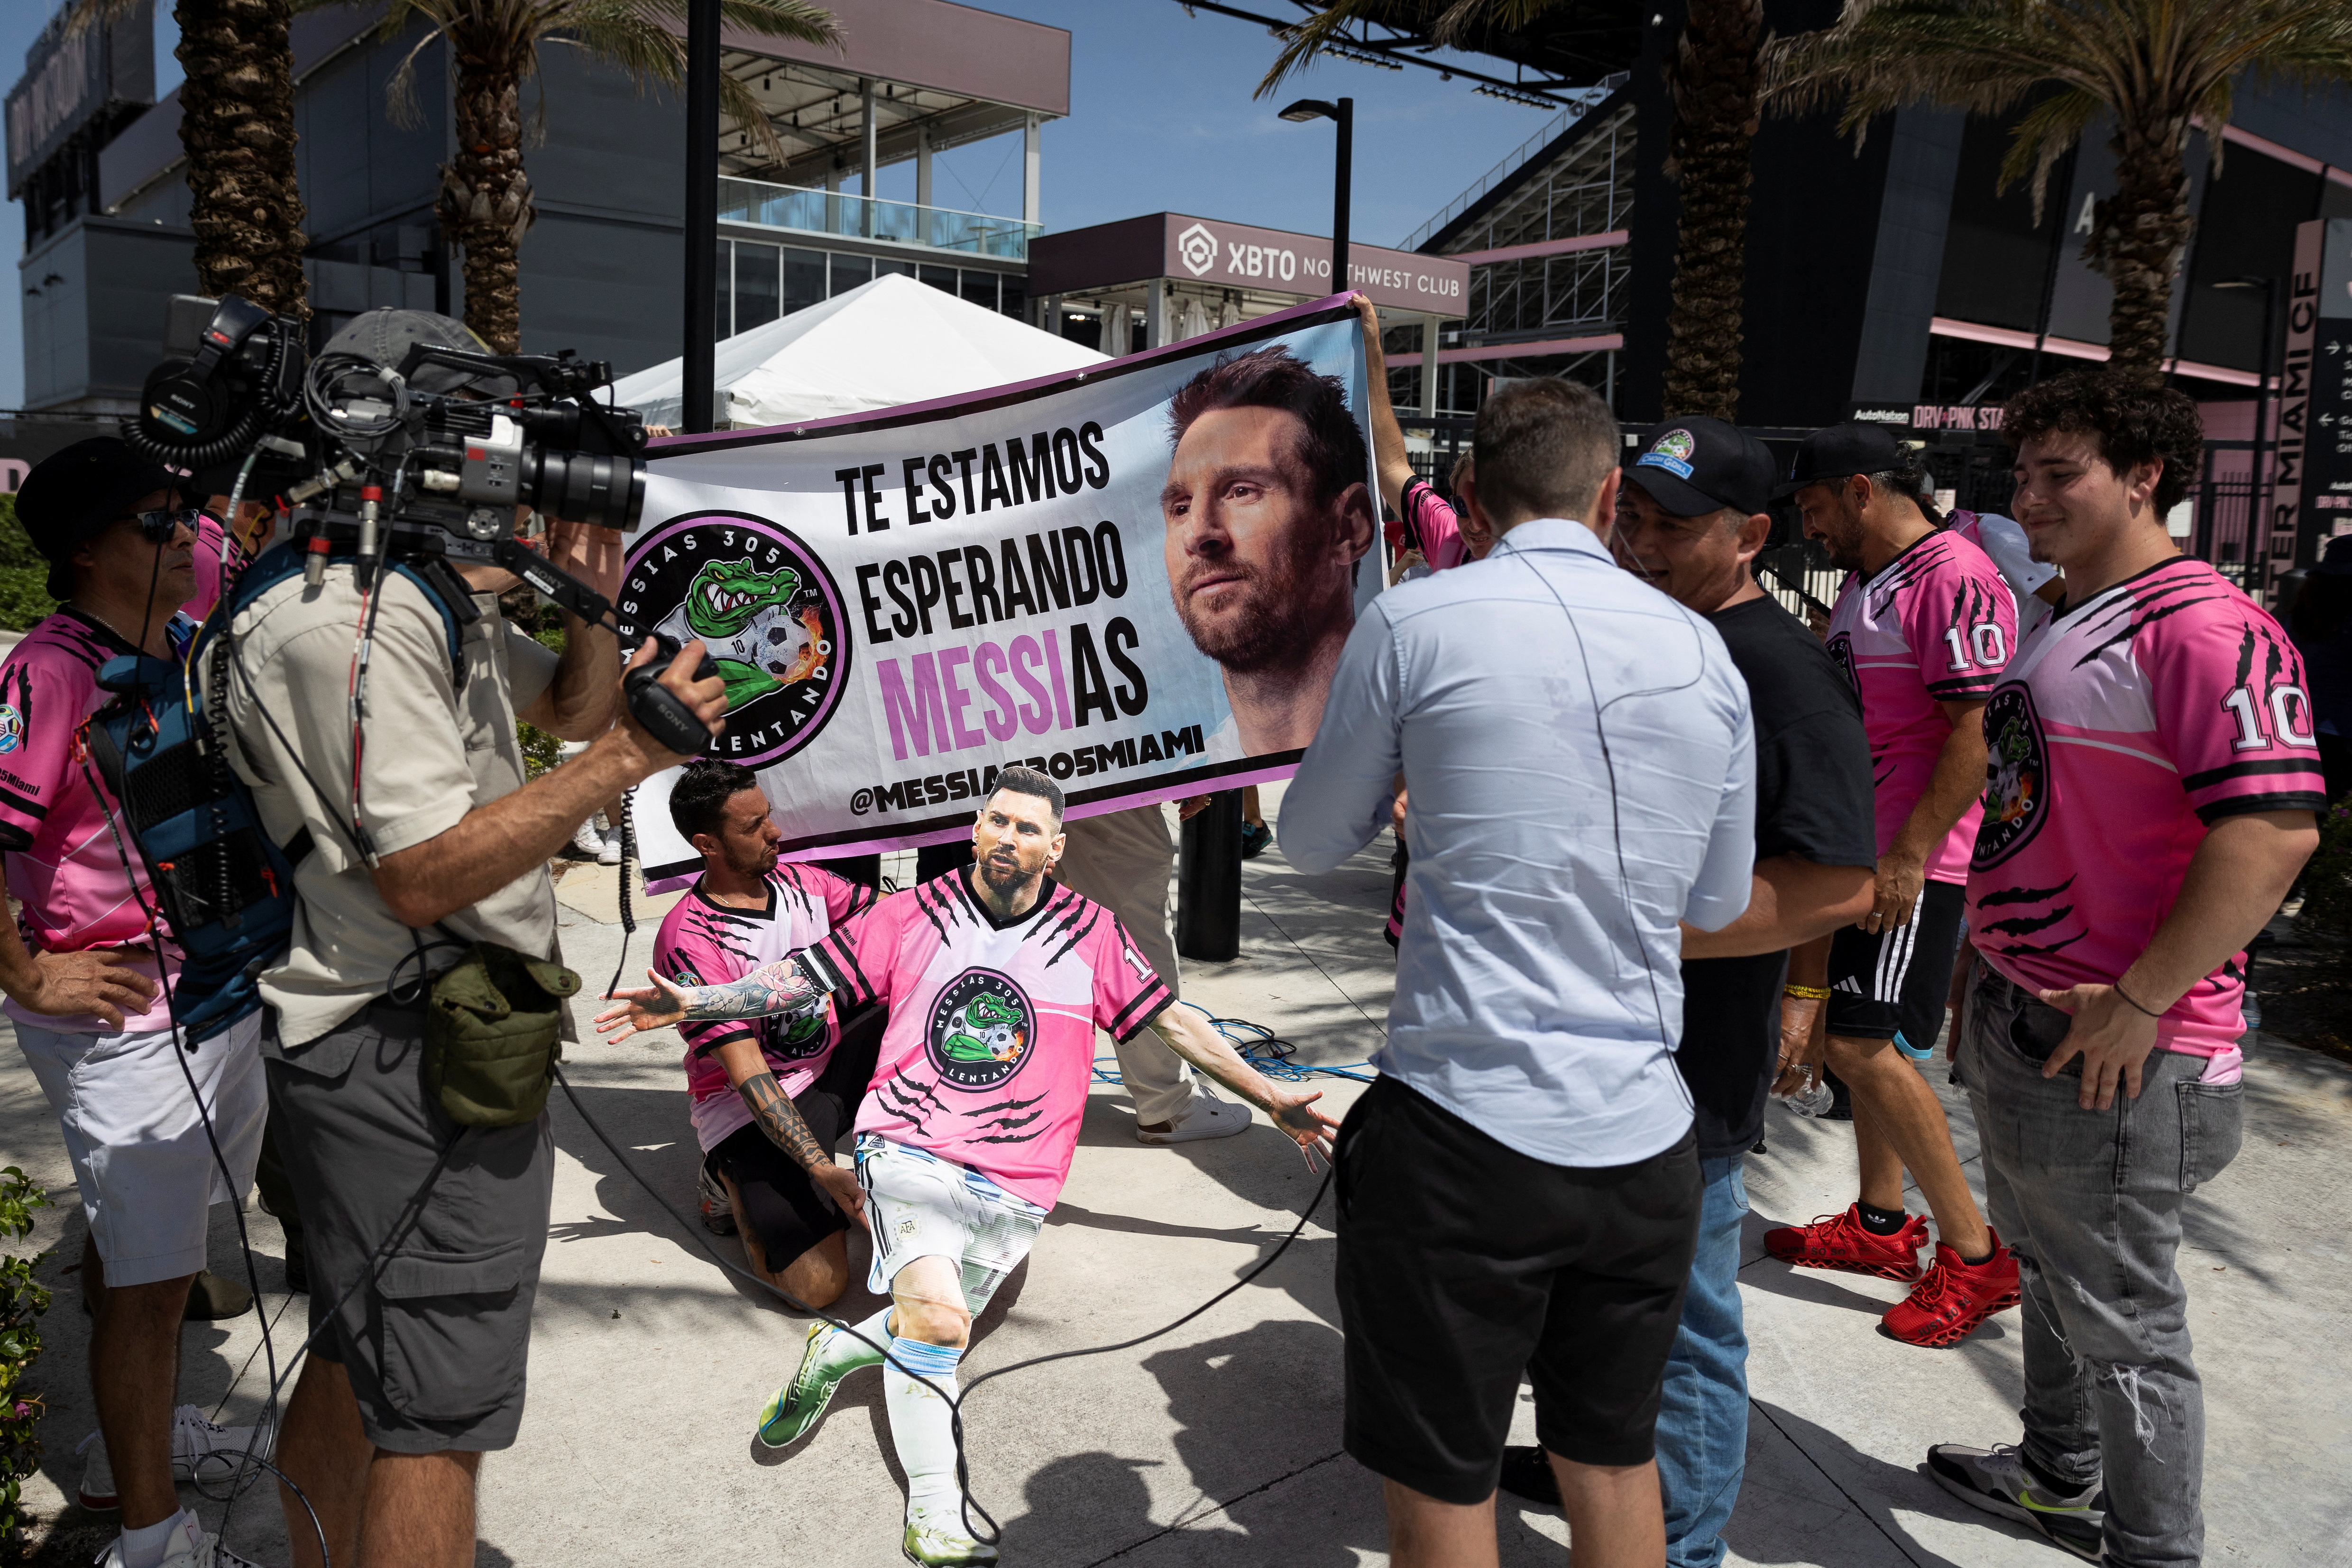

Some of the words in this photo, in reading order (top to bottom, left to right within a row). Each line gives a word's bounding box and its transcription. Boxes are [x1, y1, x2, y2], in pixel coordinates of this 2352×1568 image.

[1227, 242, 1296, 281] XBTO
[1303, 257, 1412, 290] NOTHWEST
[1417, 275, 1460, 298] CLUB
[2291, 271, 2318, 334] CF
[1853, 409, 1910, 422] AutoNation
[1912, 405, 1944, 429] DRV
[1946, 406, 1976, 430] PNK
[2278, 349, 2312, 486] MIAMI
[835, 462, 891, 536] TE
[902, 420, 1111, 526] ESTAMOS
[528, 562, 567, 591] SONY
[620, 534, 698, 664] MESSIAS
[723, 530, 781, 564] 305
[803, 588, 818, 598] TM
[855, 520, 1129, 645] ESPERANDO
[730, 639, 746, 656] 10
[1943, 623, 2008, 671] 10
[710, 640, 831, 752] LENTANDO
[875, 616, 1148, 761] MESSIAS
[657, 703, 689, 732] SONY
[2223, 685, 2317, 751] 10
[936, 976, 984, 1028] MESSIAS
[995, 982, 1019, 1006] 305
[900, 1220, 915, 1234] AFA
[1811, 1247, 1827, 1256] SO
[1830, 1248, 1846, 1256] SO
[1907, 1236, 1928, 1249] JUS
[1917, 1317, 1944, 1337] JUST
[1944, 1306, 1959, 1322] SO
